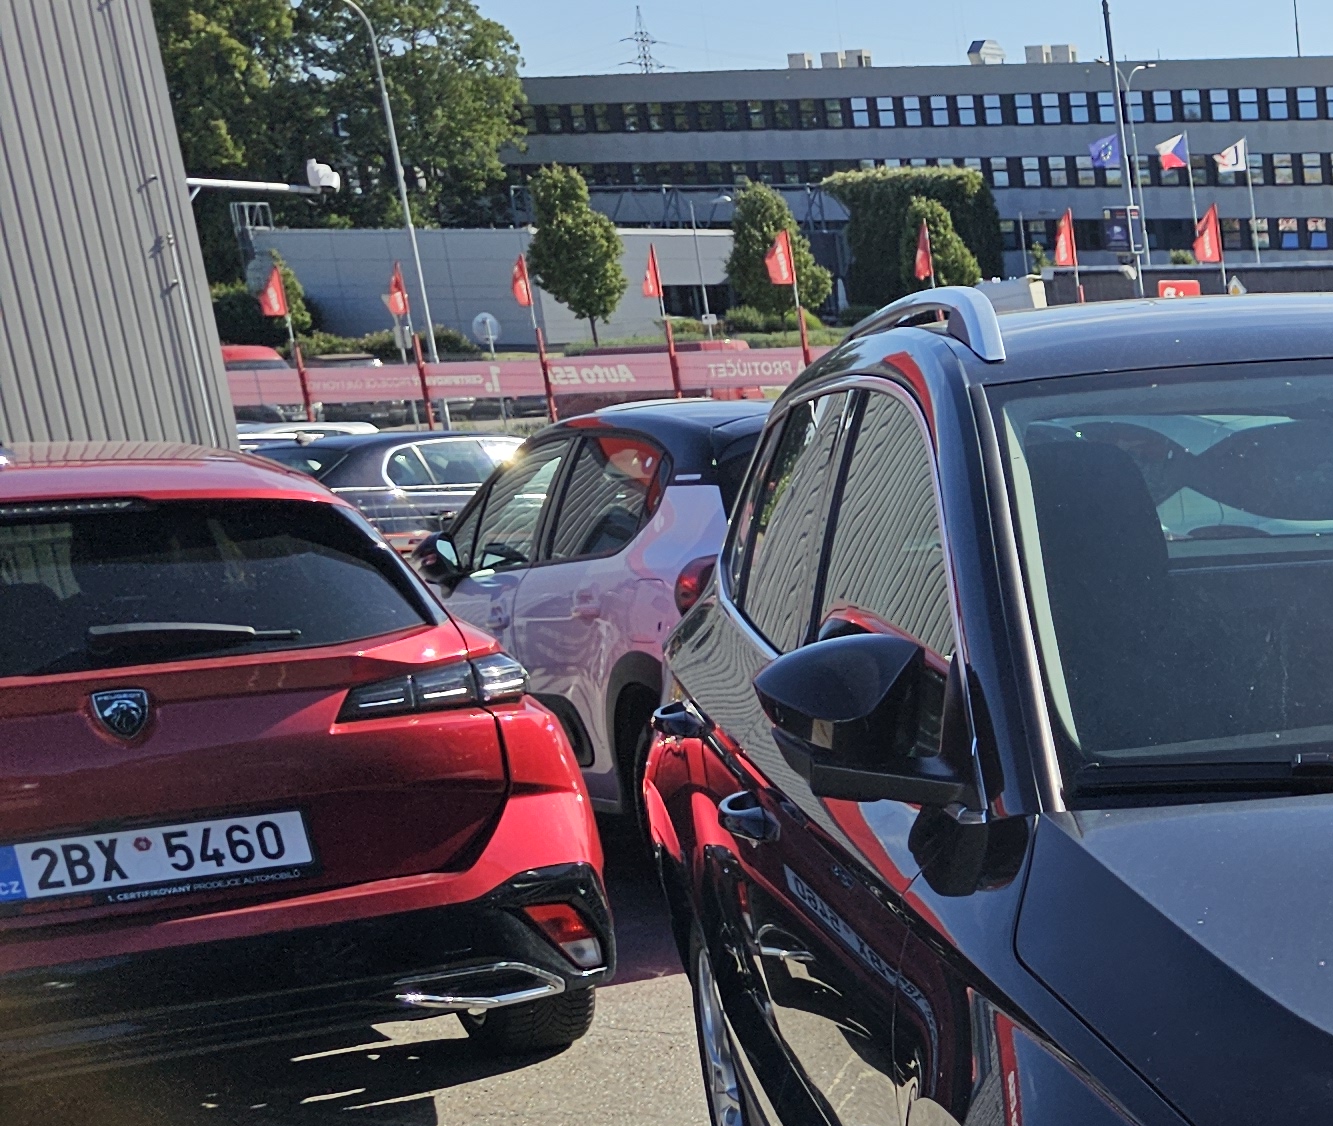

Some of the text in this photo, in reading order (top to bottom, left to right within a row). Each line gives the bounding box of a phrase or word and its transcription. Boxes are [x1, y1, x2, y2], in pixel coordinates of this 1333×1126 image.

[31, 820, 285, 890] 2BX 5460
[117, 883, 191, 901] CERTIFIKOVANÝ
[193, 878, 241, 892] PRODEJCE
[243, 869, 300, 885] AUTOMOBILŮ
